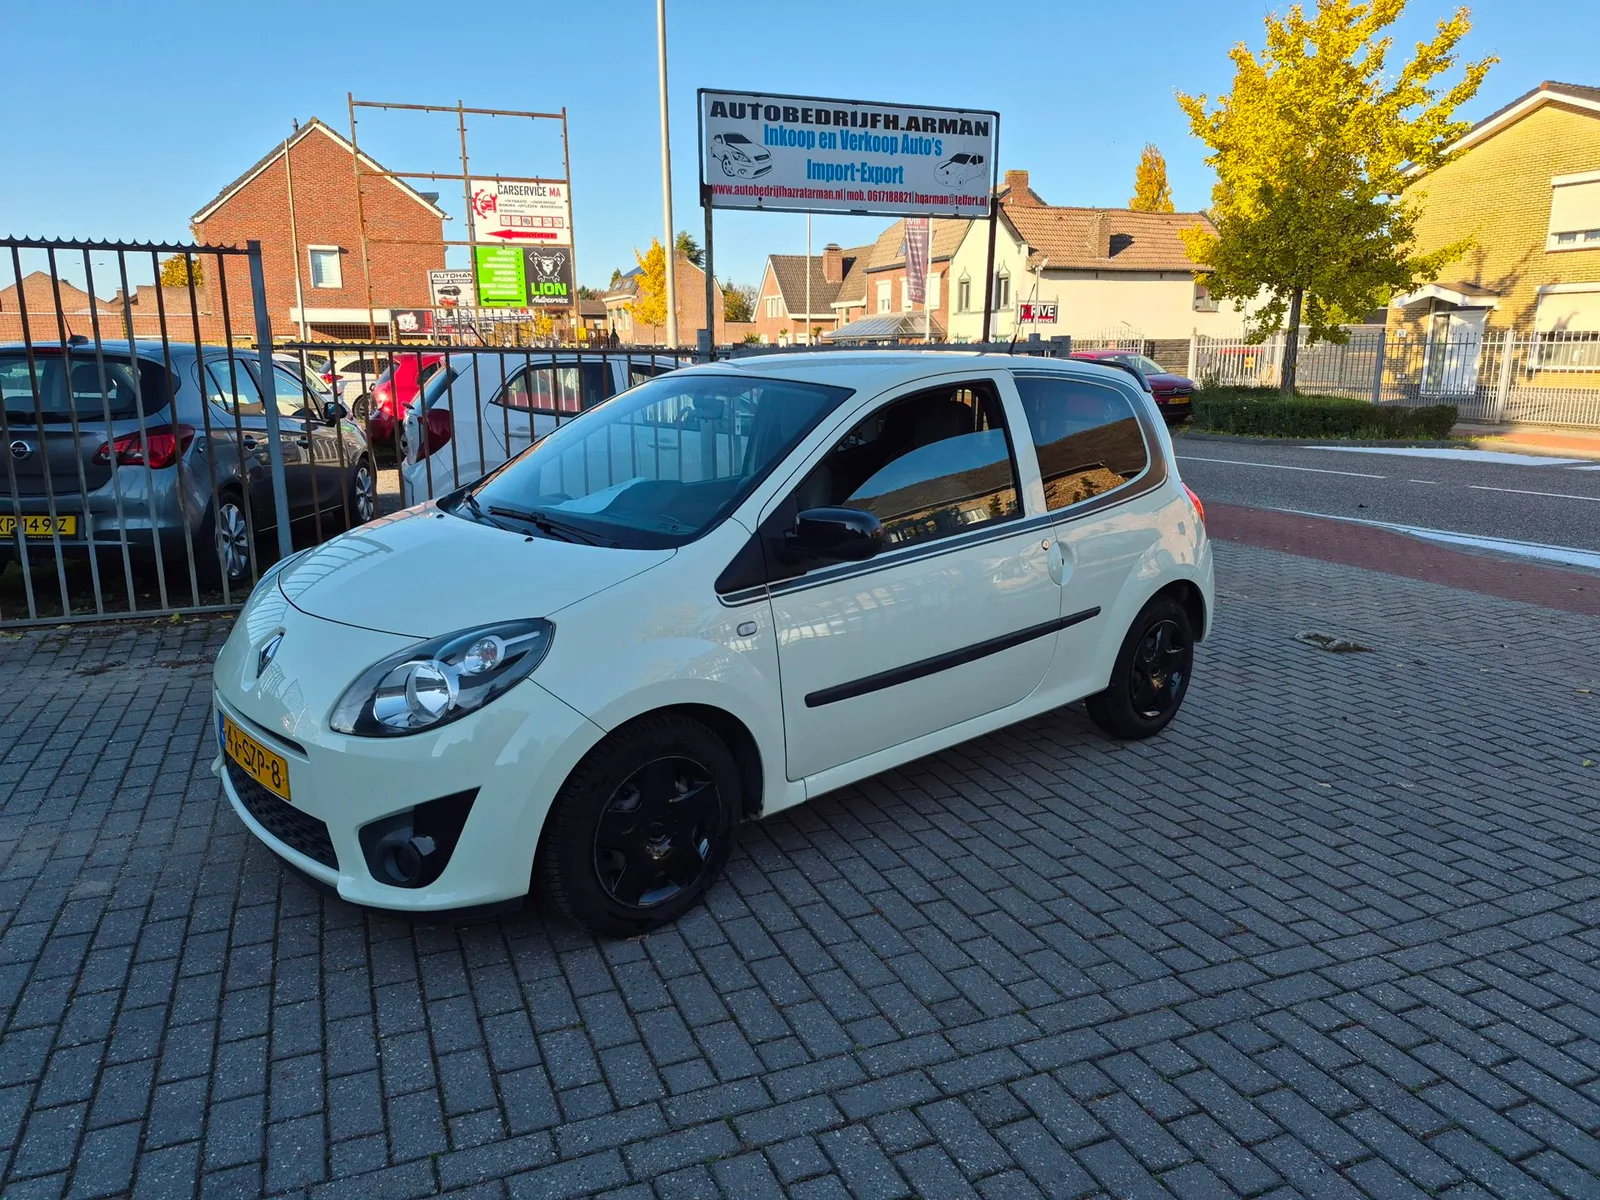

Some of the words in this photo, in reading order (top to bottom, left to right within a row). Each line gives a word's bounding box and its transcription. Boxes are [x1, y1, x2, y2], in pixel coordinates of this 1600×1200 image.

[710, 101, 989, 137] AUTOBEDRIJFH.ARMAN
[764, 124, 816, 150] Inkoop
[818, 131, 837, 149] en
[840, 129, 898, 155] Verkoop
[901, 134, 943, 156] Auto's
[806, 159, 904, 185] Import-Export
[497, 184, 547, 197] CARSERVICE
[549, 187, 561, 197] MA
[531, 282, 567, 295] LION
